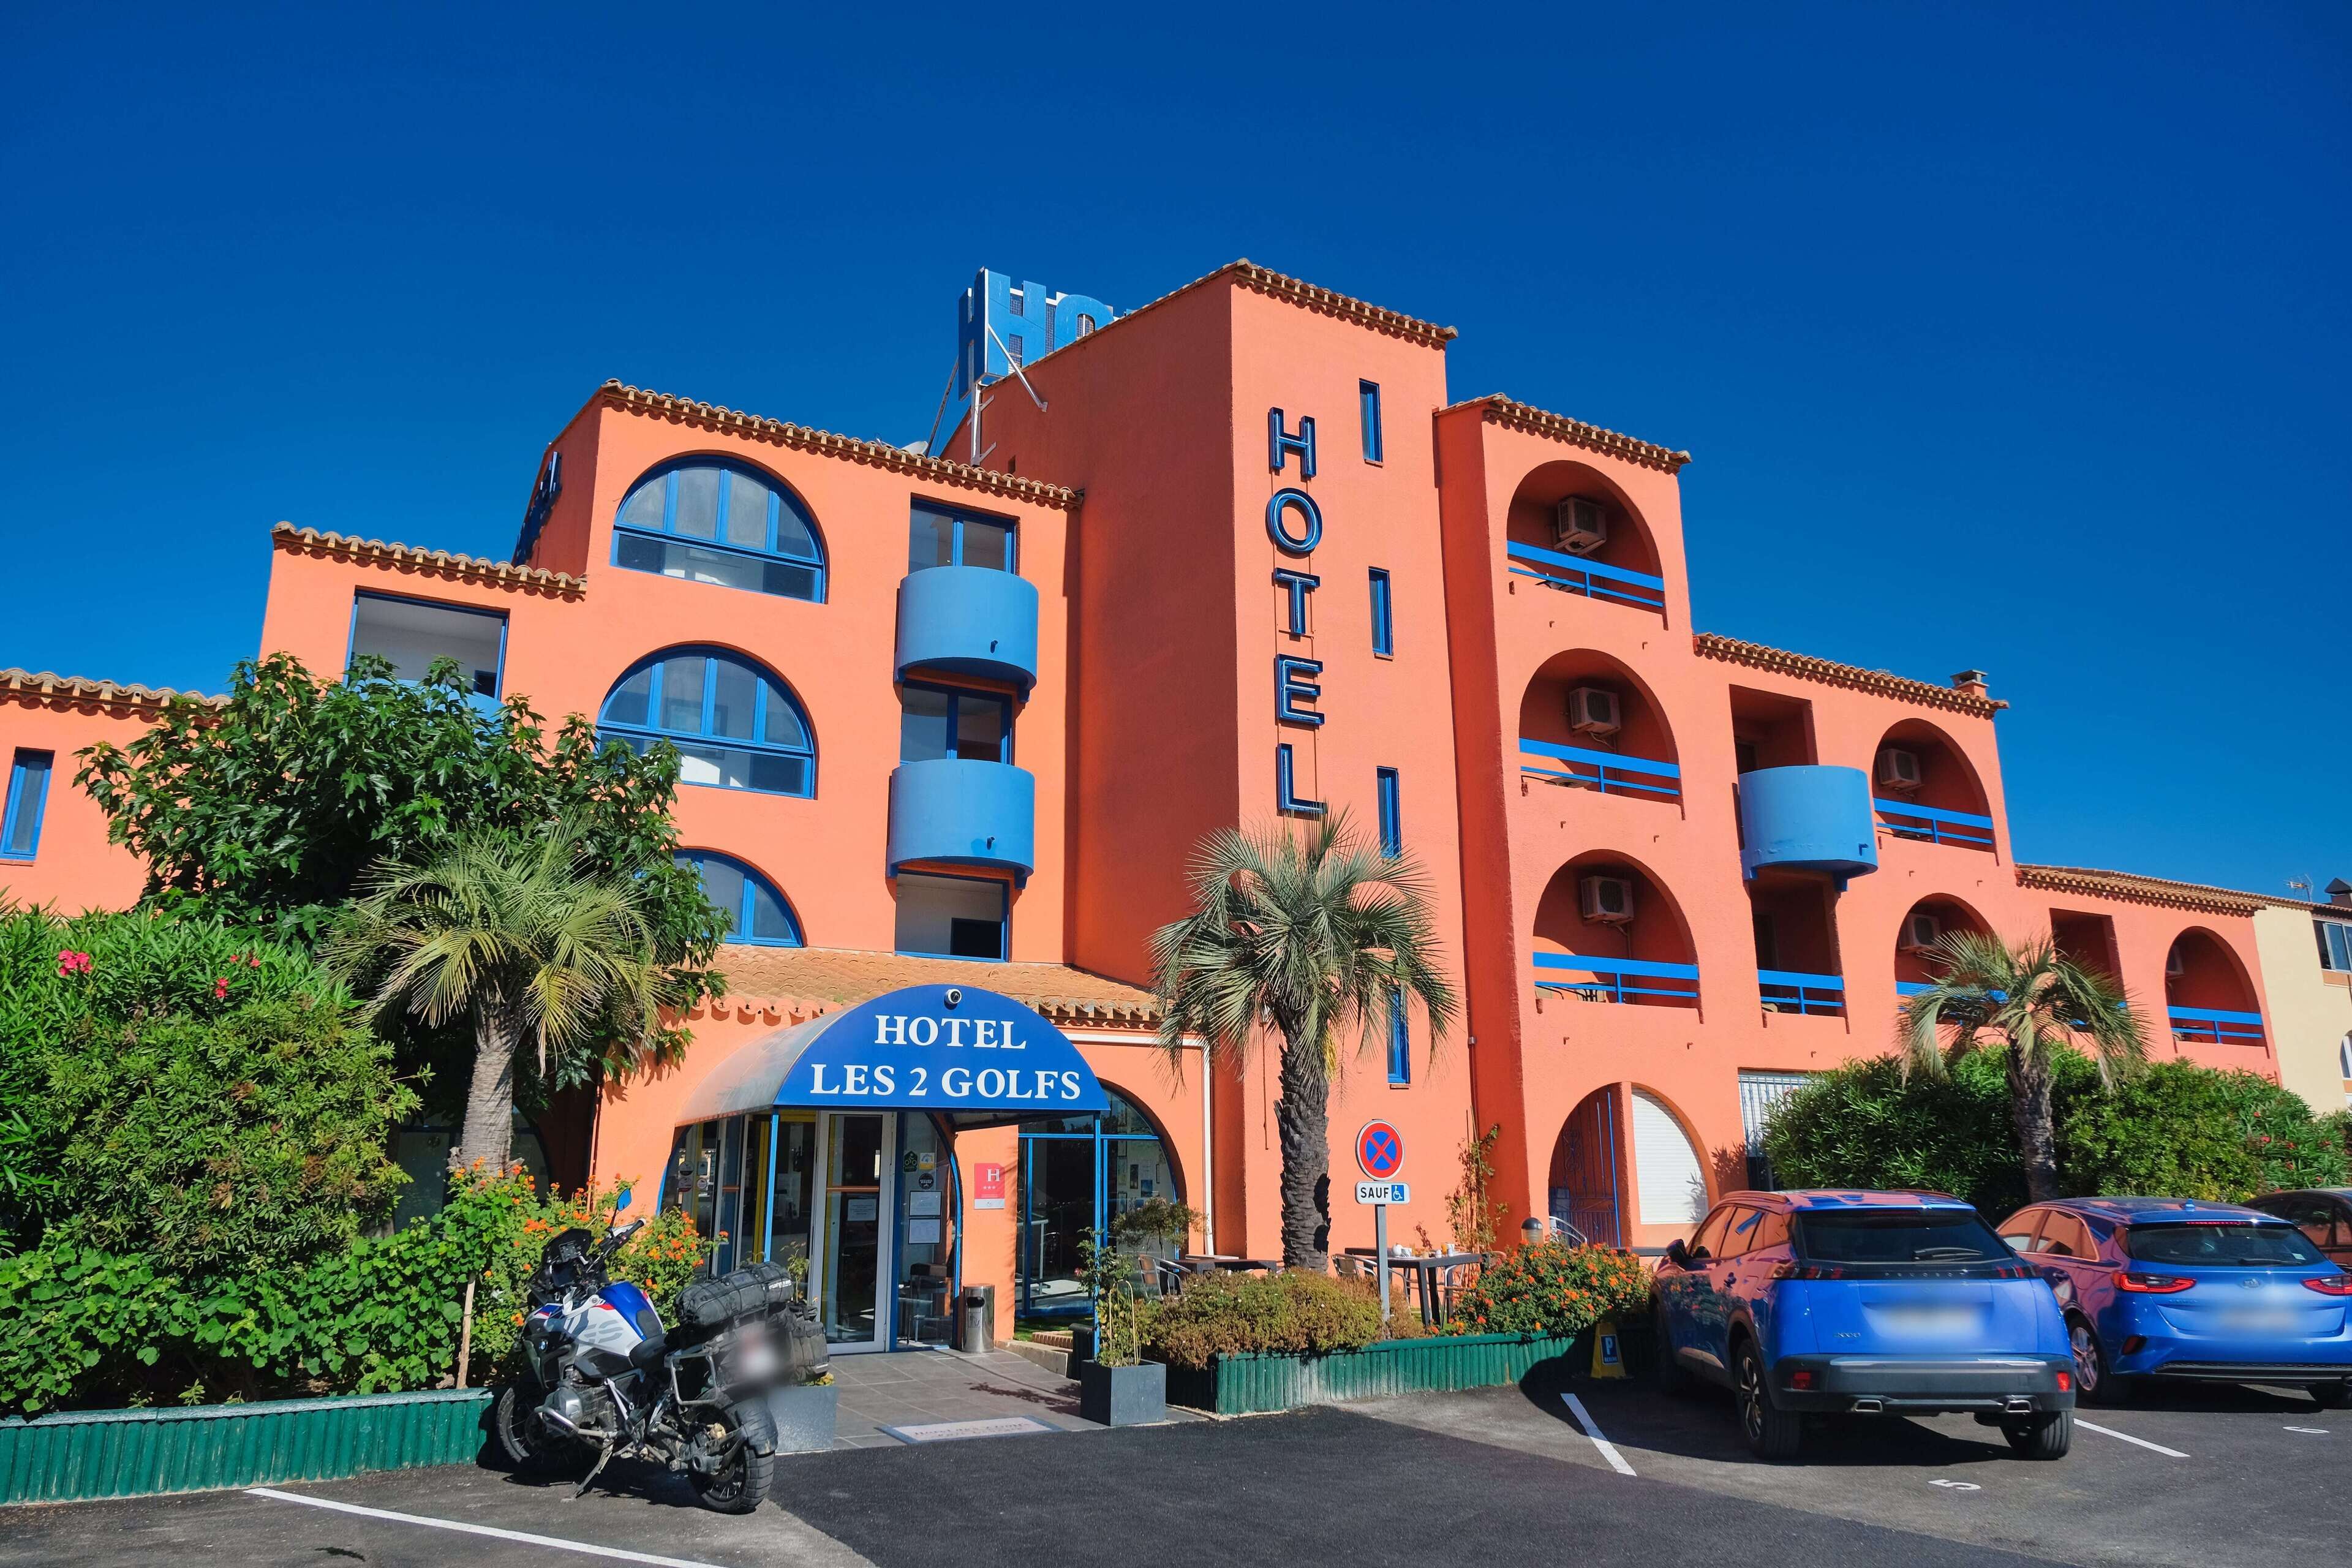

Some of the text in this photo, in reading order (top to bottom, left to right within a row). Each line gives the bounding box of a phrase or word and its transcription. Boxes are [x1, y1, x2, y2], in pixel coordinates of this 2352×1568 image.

[985, 268, 1136, 378] HO
[1266, 407, 1328, 815] HOTEL
[875, 1015, 1027, 1049] HOTEL
[810, 1064, 1080, 1099] LES 2 GOLFS
[987, 1168, 1000, 1182] H
[1360, 1186, 1389, 1198] SAUF
[1605, 1337, 1613, 1355] P
